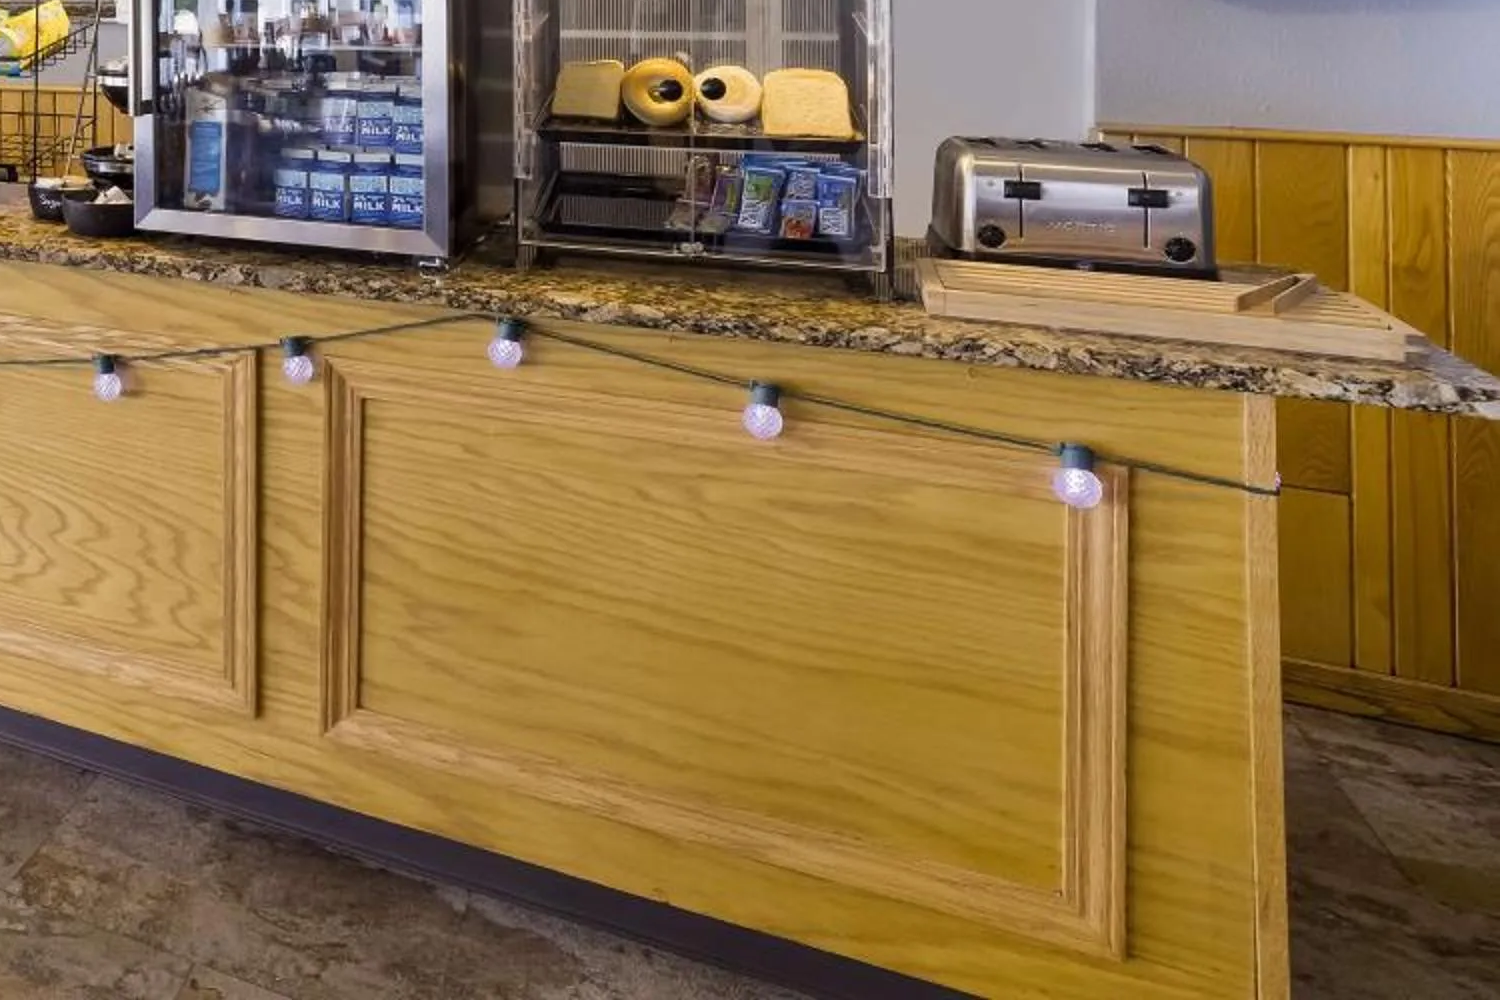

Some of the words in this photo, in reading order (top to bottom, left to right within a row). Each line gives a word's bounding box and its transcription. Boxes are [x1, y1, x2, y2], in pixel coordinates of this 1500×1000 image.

[361, 125, 393, 136] MILK
[312, 197, 341, 210] MILK
[353, 200, 386, 212] MILK
